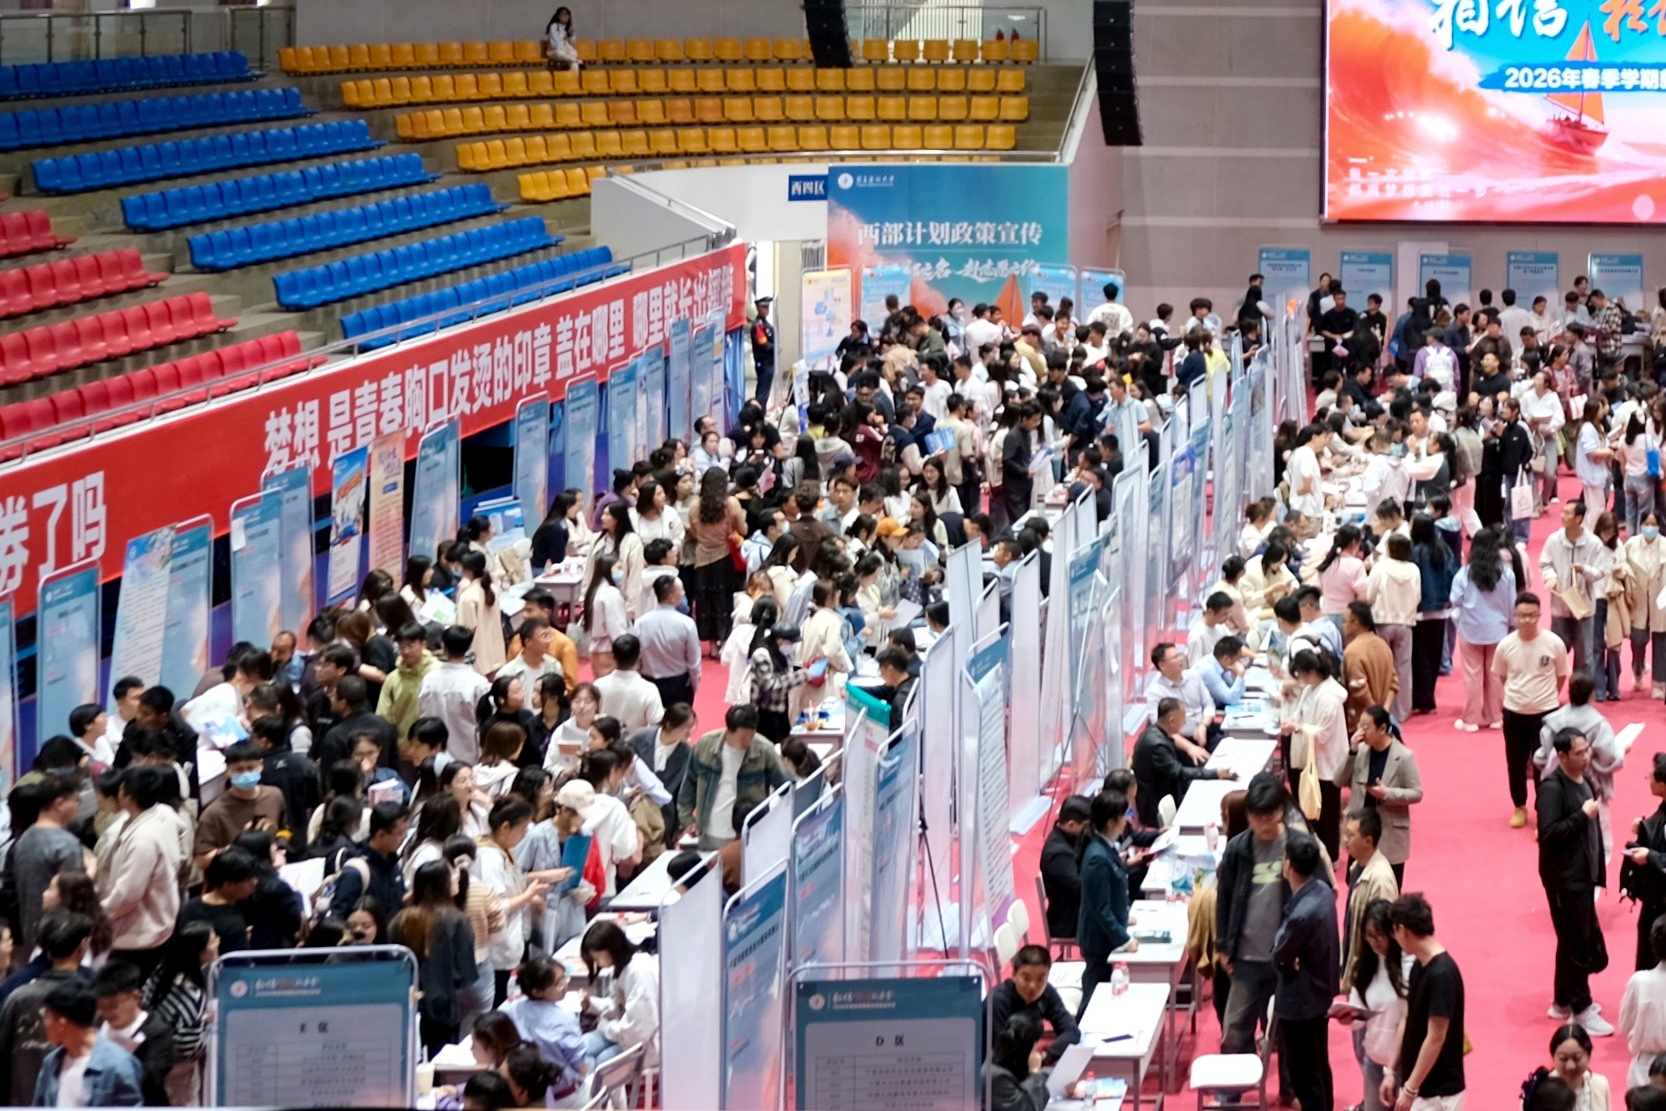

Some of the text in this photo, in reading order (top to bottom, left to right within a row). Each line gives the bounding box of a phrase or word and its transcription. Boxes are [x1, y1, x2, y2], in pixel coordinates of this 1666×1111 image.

[790, 179, 825, 196] 西四区
[857, 221, 1042, 247] 西部计划政策宣传
[264, 399, 320, 477] 梦想
[327, 322, 552, 466] 是青春胸口发烫的印章
[556, 299, 625, 379] 盖在哪里
